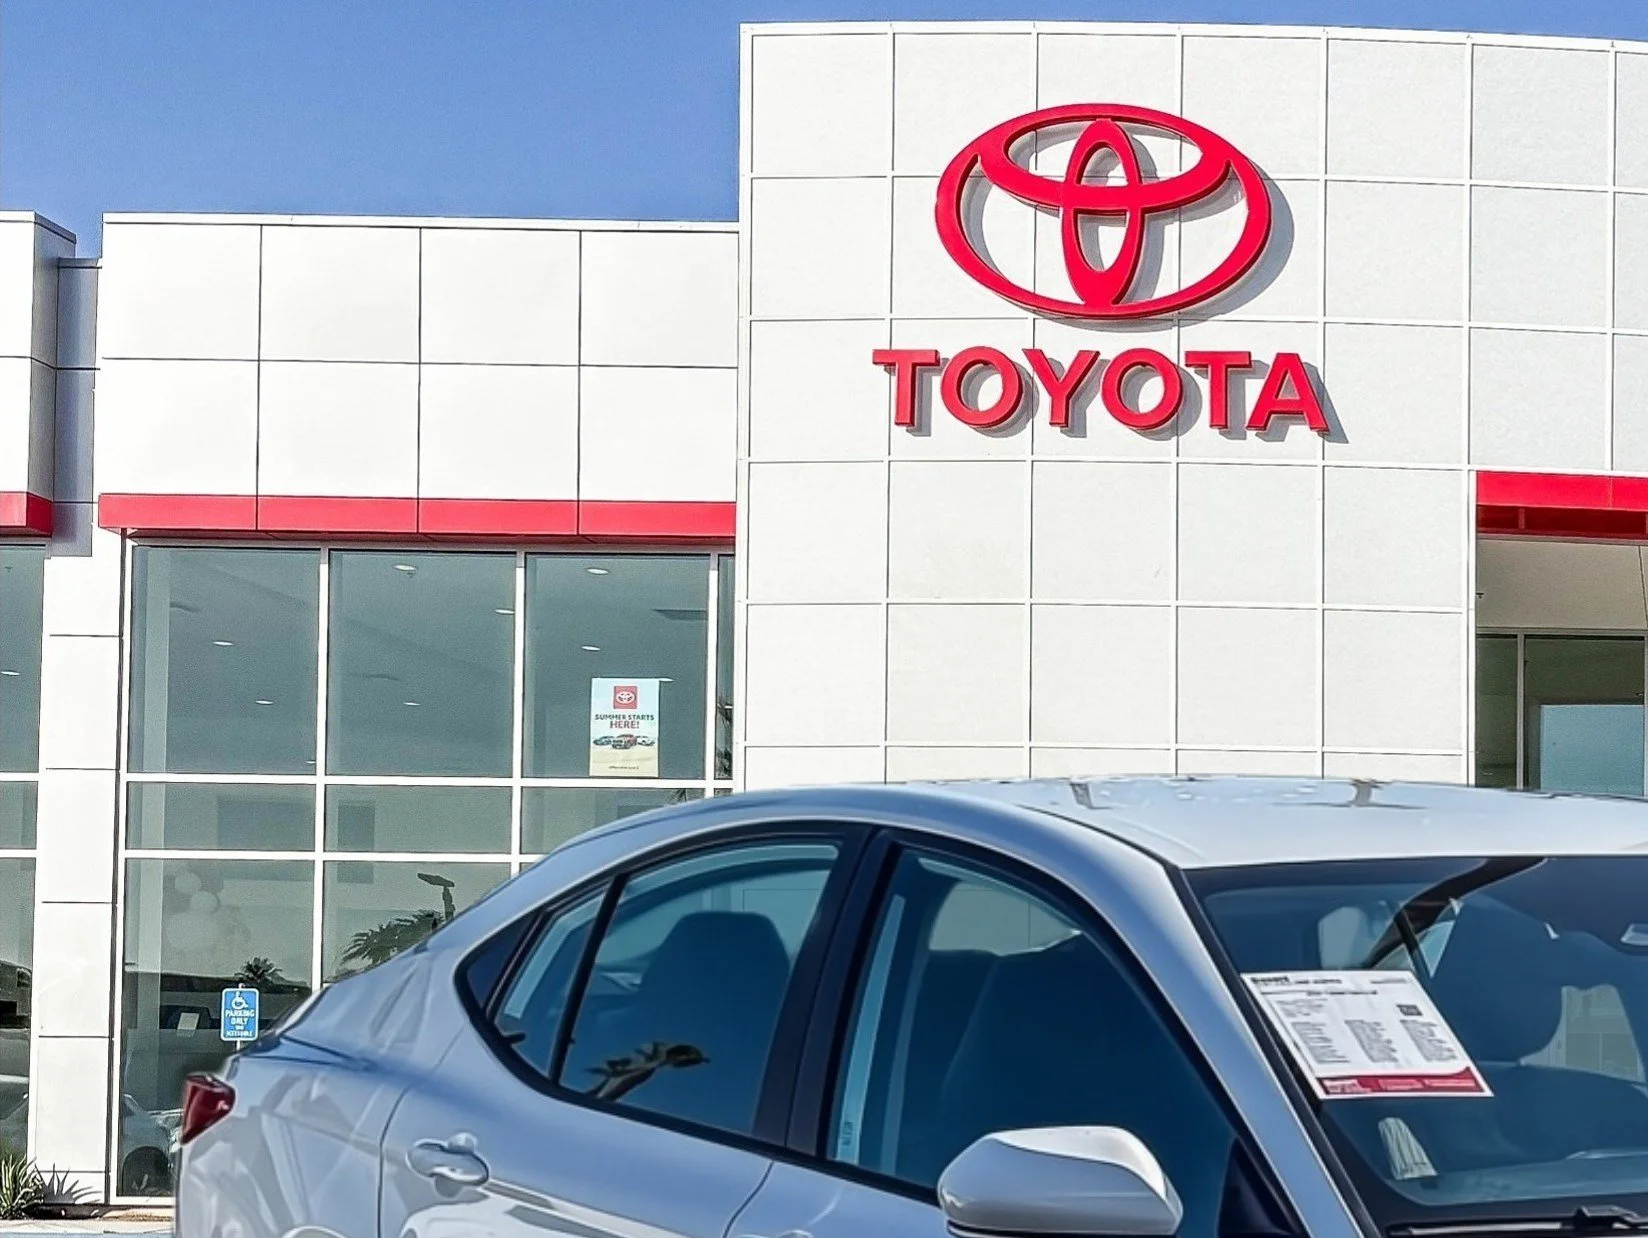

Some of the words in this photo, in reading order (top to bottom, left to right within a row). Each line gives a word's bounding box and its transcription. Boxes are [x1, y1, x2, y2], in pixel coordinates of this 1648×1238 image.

[872, 346, 1330, 435] TOYOTA
[609, 720, 640, 729] HERE!
[230, 1017, 249, 1025] ONLY
